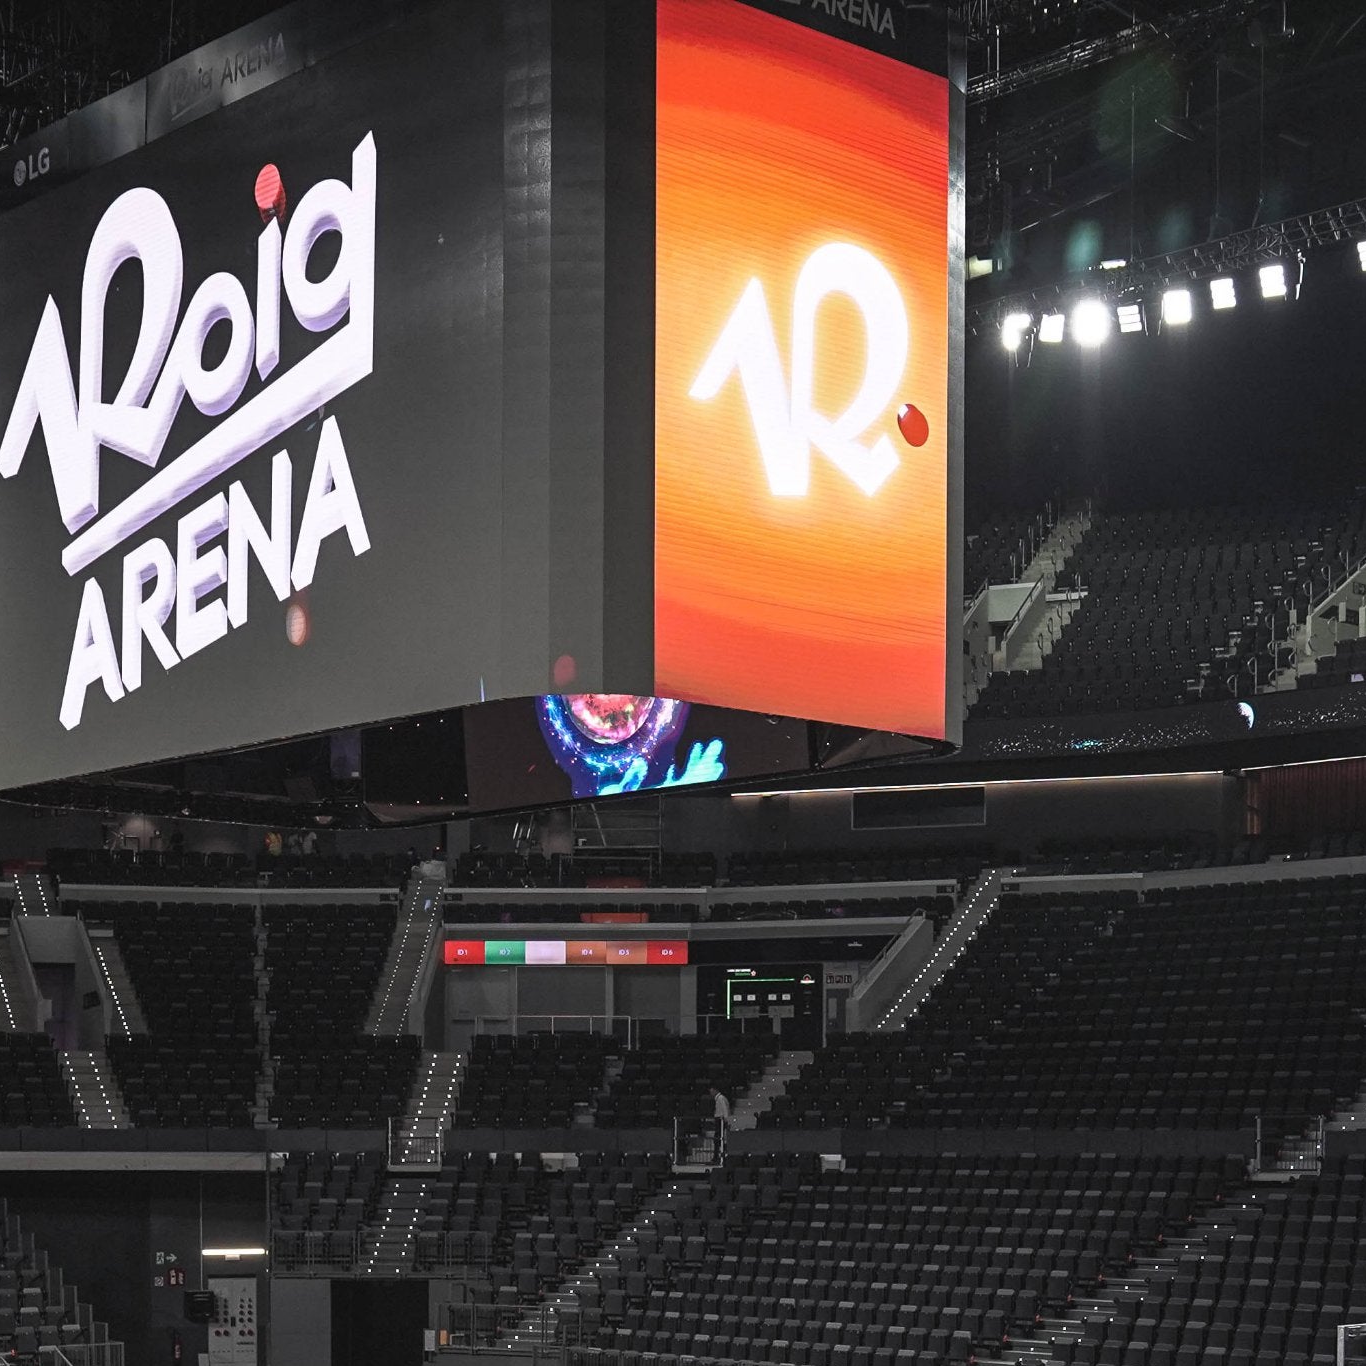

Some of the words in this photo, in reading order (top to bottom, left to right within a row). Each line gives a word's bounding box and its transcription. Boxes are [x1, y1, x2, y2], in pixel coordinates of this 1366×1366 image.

[220, 32, 285, 87] ARENA
[28, 147, 50, 180] LG
[58, 414, 372, 731] ARENA
